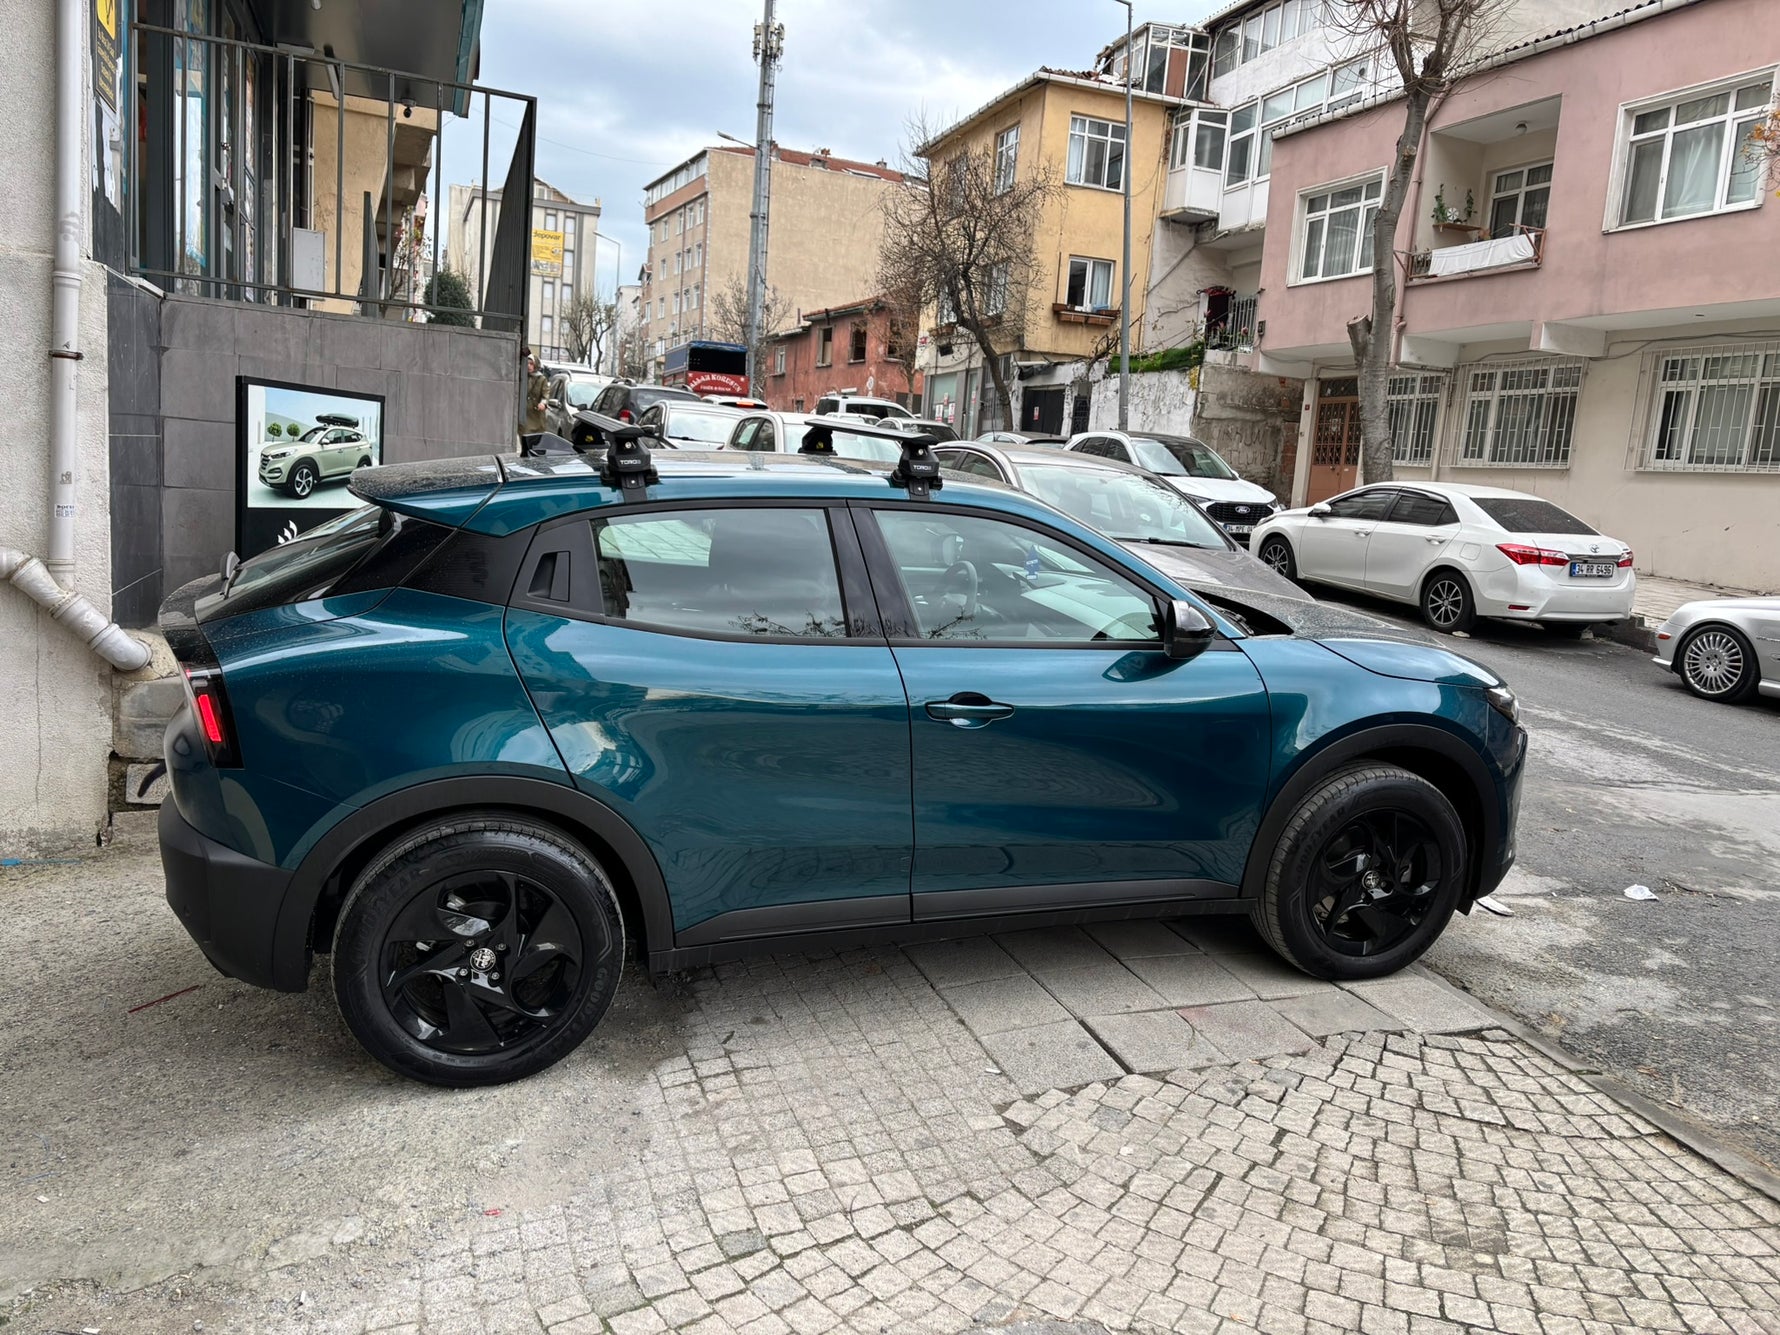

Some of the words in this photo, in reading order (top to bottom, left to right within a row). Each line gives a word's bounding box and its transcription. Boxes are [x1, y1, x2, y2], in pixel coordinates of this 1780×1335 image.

[689, 375, 711, 388] ALLAH
[1576, 564, 1584, 574] 34
[1586, 564, 1595, 574] RR
[1596, 565, 1612, 575] 6496
